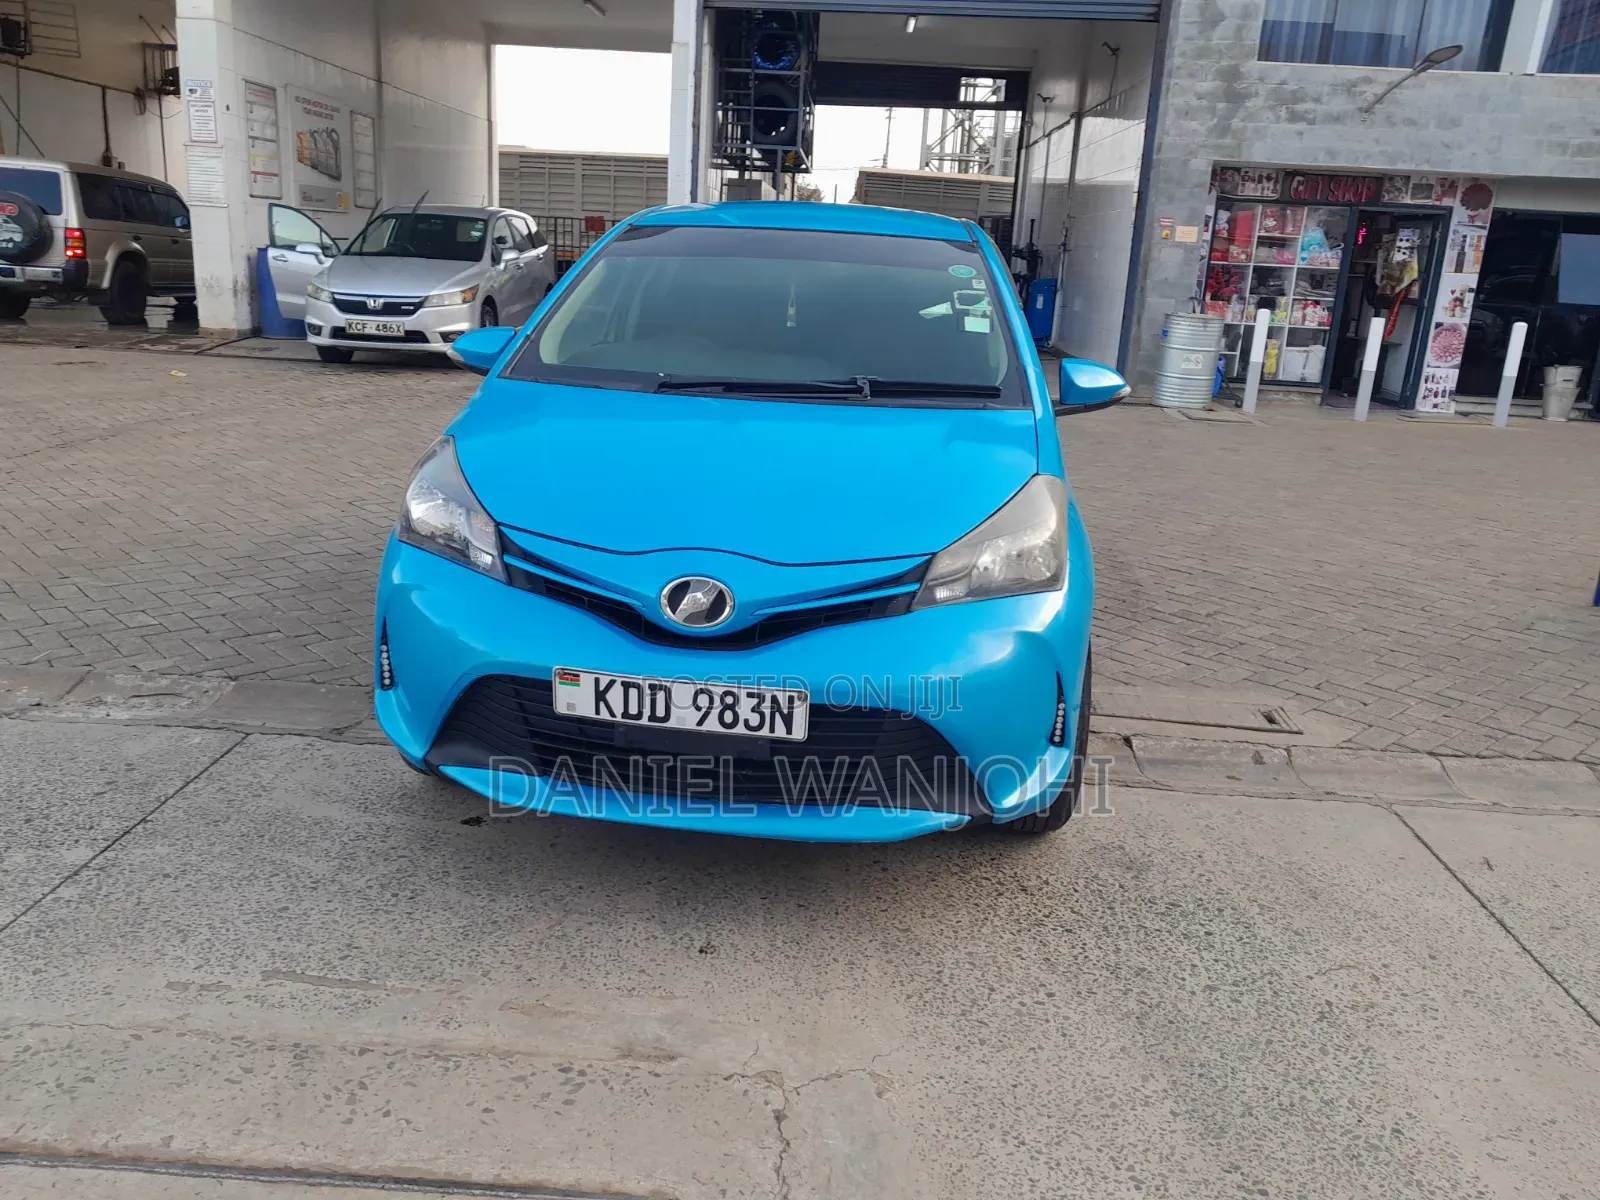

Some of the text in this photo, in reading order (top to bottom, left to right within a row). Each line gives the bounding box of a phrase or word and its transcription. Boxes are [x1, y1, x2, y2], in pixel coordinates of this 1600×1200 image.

[1328, 176, 1376, 202] SHOP
[594, 676, 672, 724] KDD
[692, 687, 796, 736] 983N
